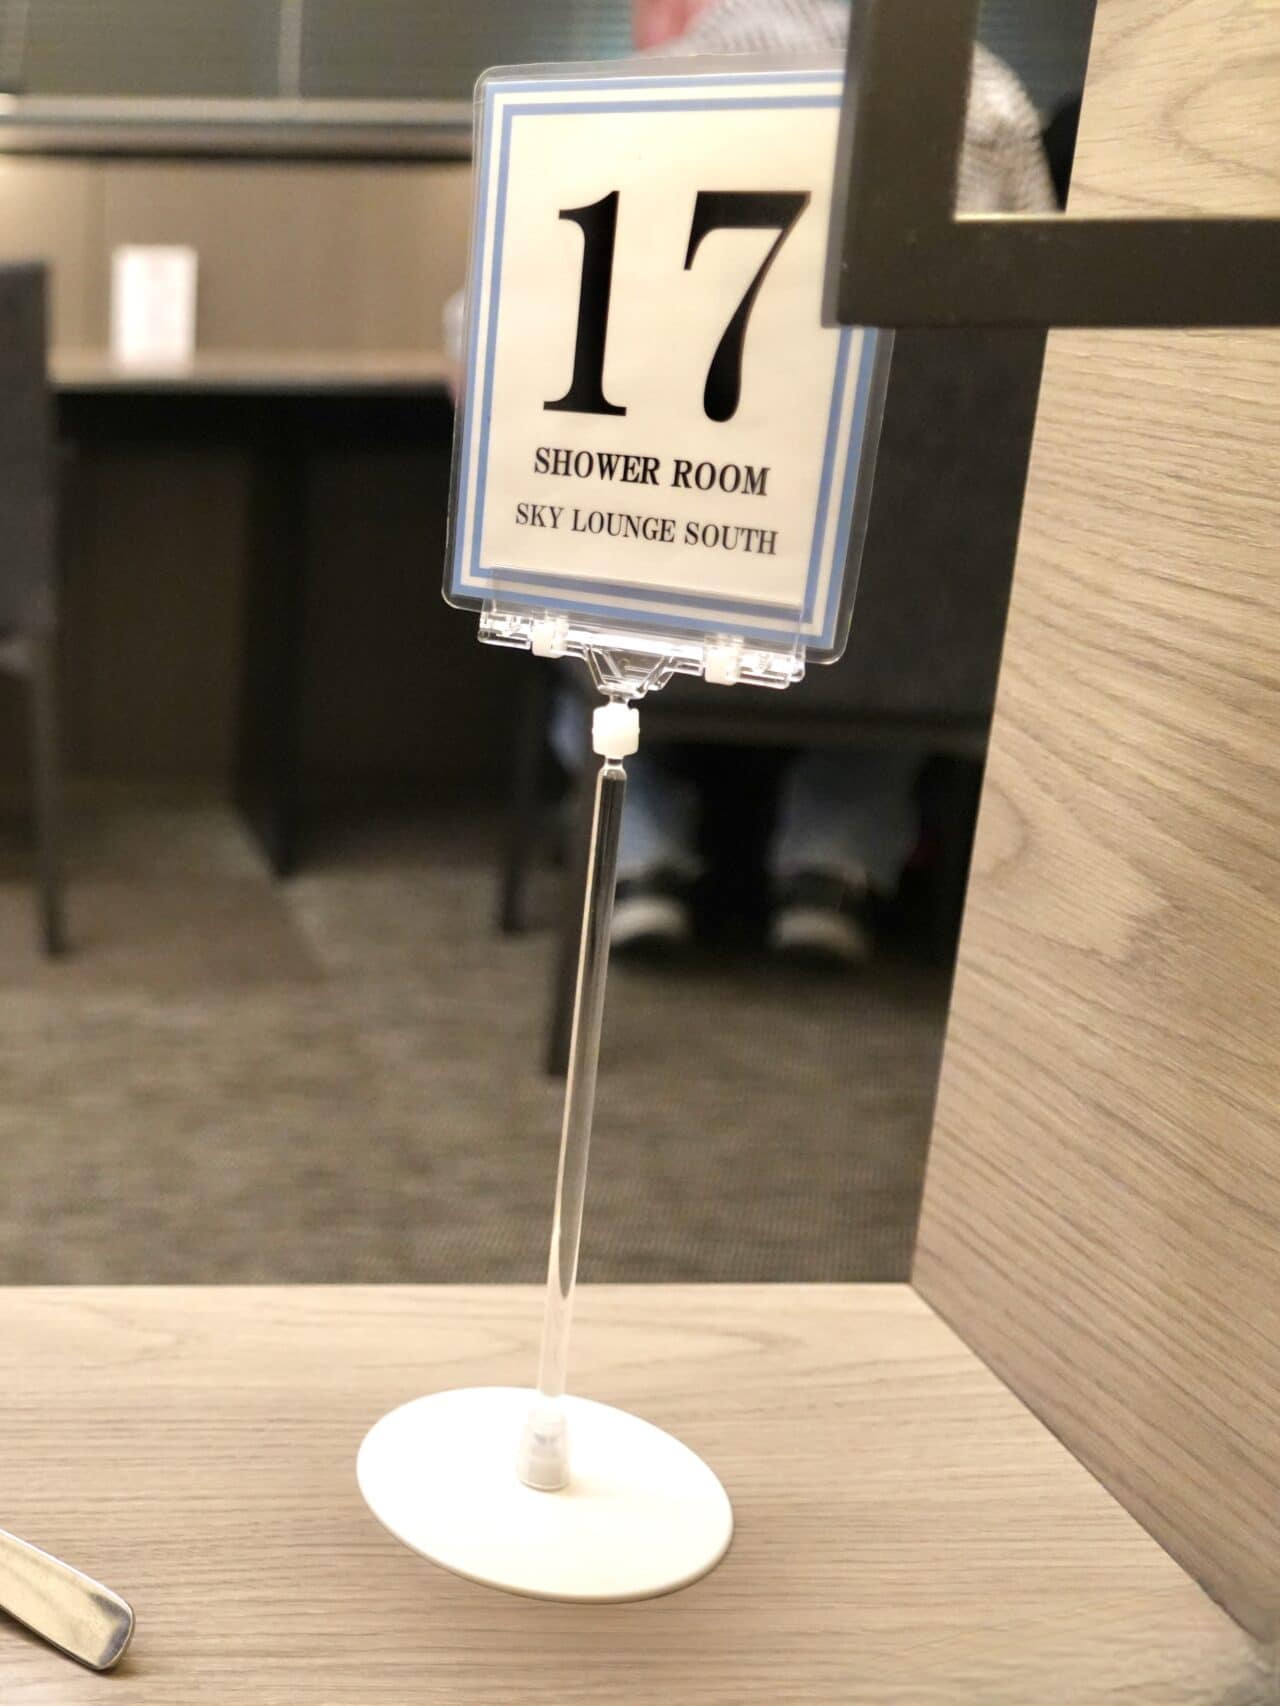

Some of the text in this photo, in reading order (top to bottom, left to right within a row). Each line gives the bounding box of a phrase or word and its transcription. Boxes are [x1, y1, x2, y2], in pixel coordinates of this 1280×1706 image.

[543, 190, 812, 423] 17
[533, 446, 771, 496] SHOWER ROOM
[515, 502, 779, 555] SKY LOUNGE SOUTH
